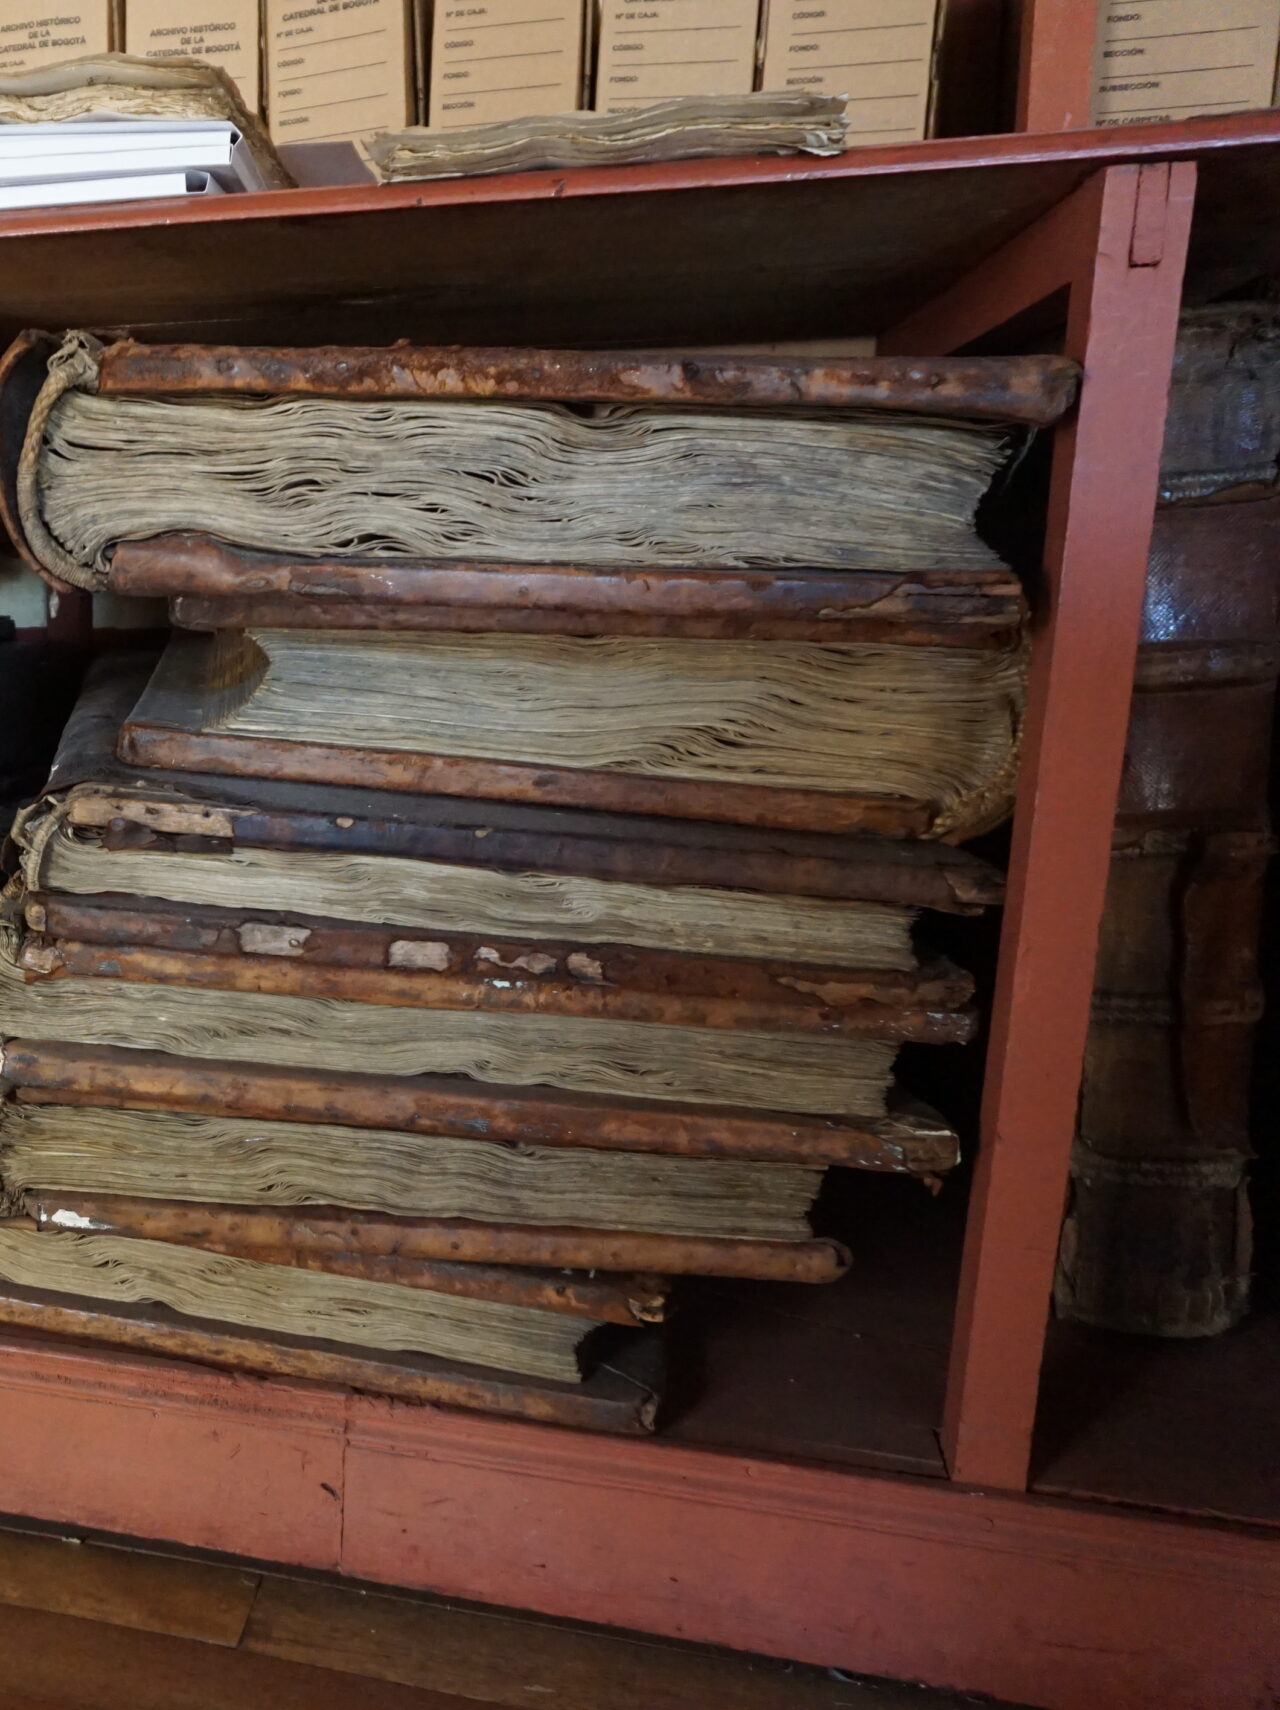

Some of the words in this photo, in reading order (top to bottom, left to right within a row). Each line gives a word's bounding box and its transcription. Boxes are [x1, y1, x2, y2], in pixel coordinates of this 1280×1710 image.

[282, 6, 326, 21] CATEDRAL
[328, 3, 340, 13] DE
[0, 21, 34, 32] ARCHIVO
[36, 15, 81, 27] HISTÓRICO
[150, 26, 188, 37] ARCHIVO
[189, 22, 236, 33] HISTÓRICO
[28, 31, 39, 39] DE
[40, 29, 51, 37] LA
[39, 40, 48, 48] DE
[51, 35, 86, 47] BOGOTÁ
[180, 37, 192, 45] DE
[194, 36, 204, 44] LA
[146, 47, 189, 57] CATEDRAL
[192, 46, 203, 54] DE
[205, 41, 241, 53] BOGOTÁ
